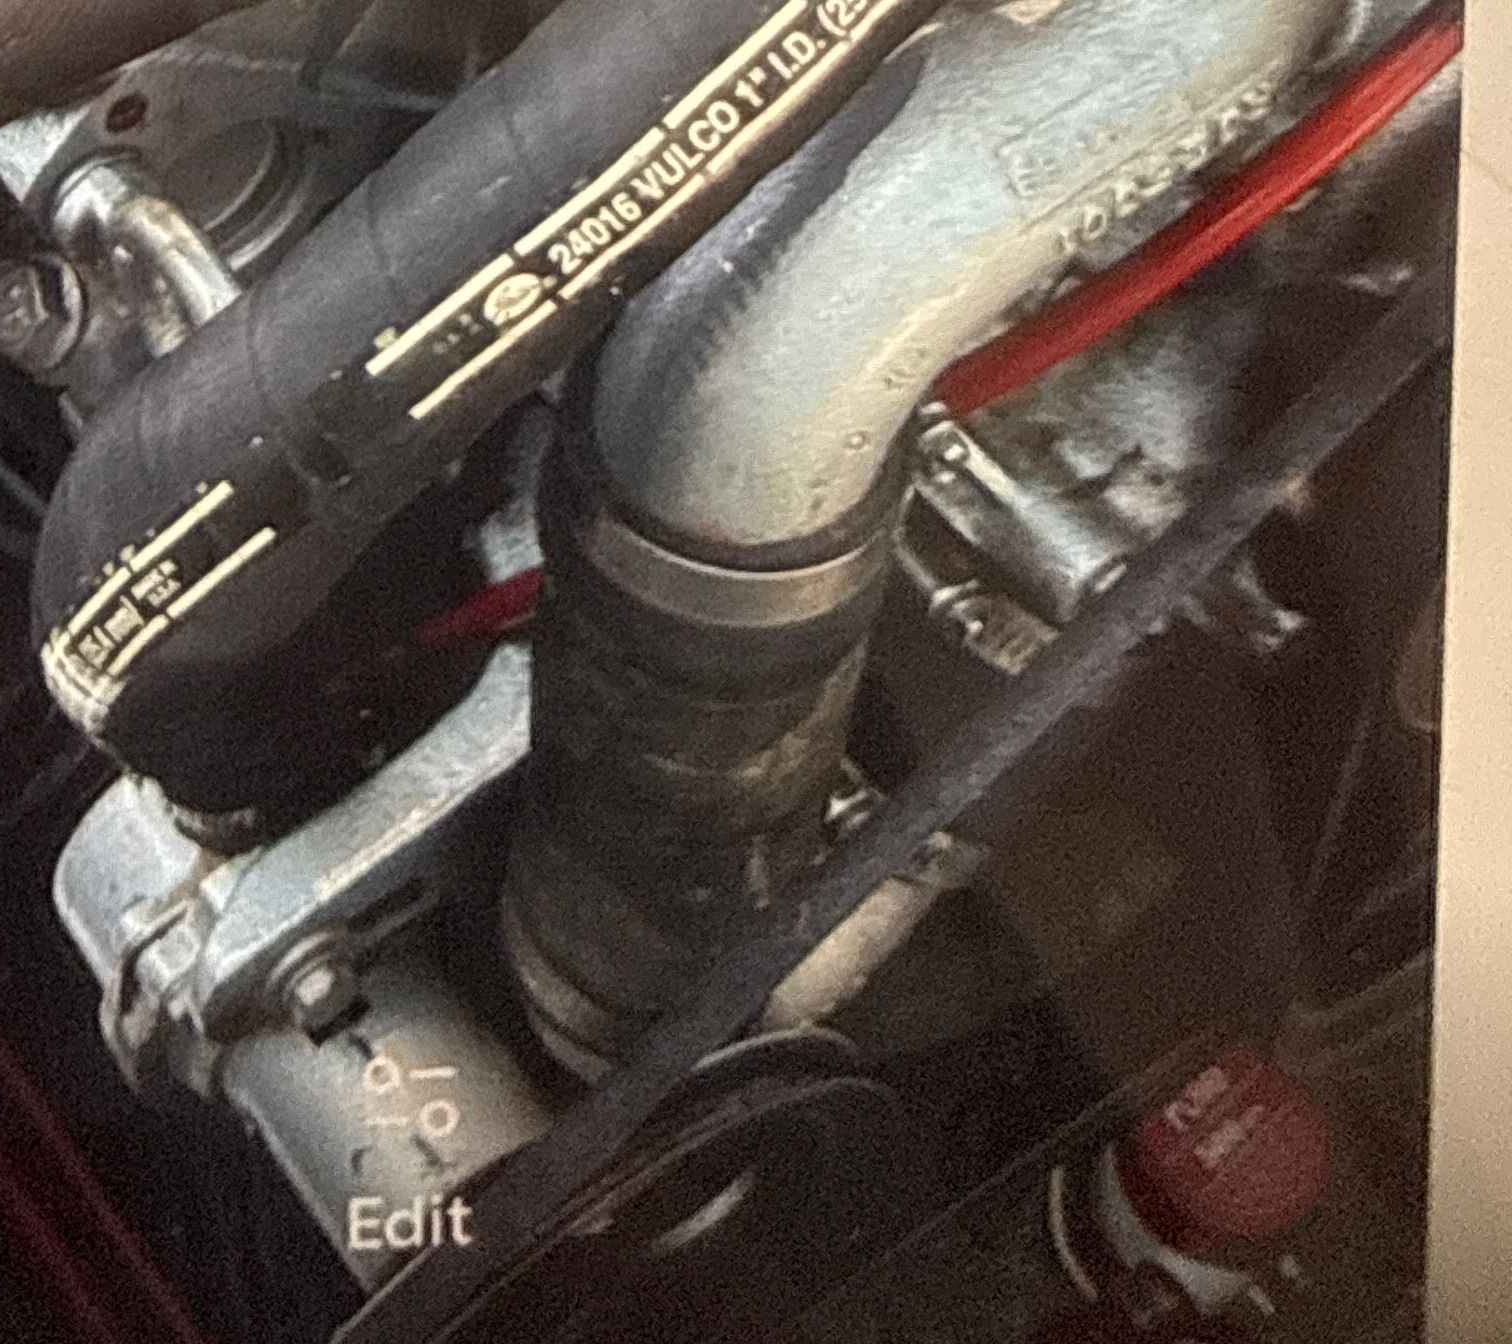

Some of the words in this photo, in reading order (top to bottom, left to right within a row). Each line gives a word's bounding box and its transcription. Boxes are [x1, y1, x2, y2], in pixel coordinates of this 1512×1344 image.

[548, 191, 643, 273] 24016
[632, 101, 741, 201] VULCO
[767, 30, 827, 79] I.D.
[349, 1193, 473, 1249] Edit
